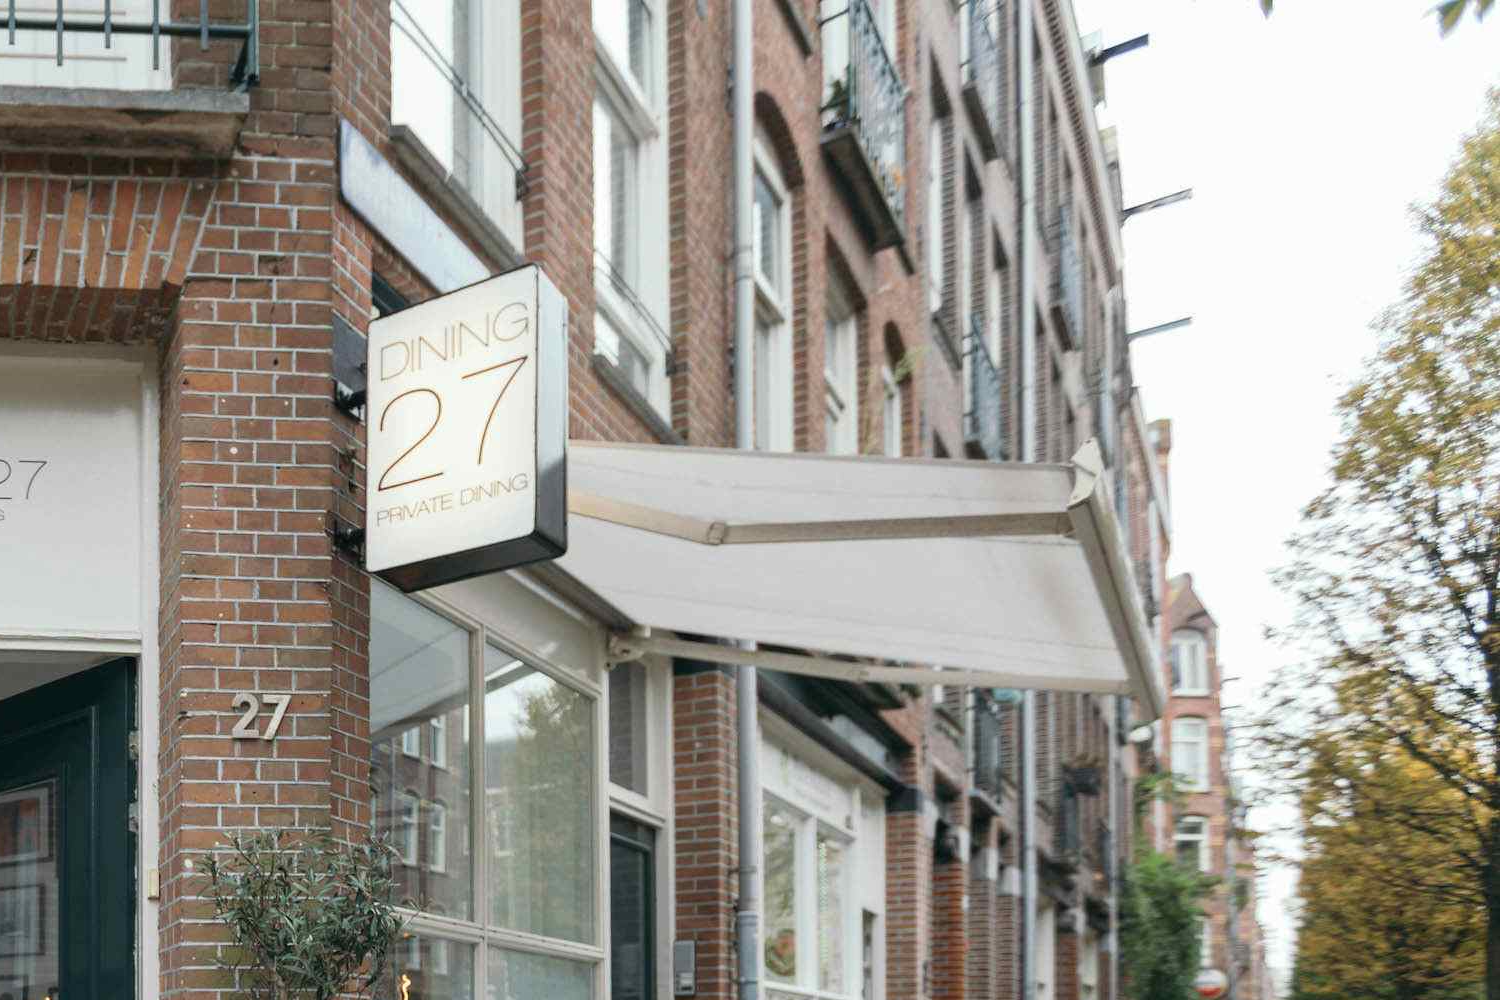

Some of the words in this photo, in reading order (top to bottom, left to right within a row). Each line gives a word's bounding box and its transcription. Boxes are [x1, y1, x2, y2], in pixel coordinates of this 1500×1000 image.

[380, 302, 529, 381] DINING
[377, 355, 529, 491] 27
[376, 491, 453, 527] PRIVATE
[460, 472, 529, 508] DINING
[231, 693, 292, 741] 27
